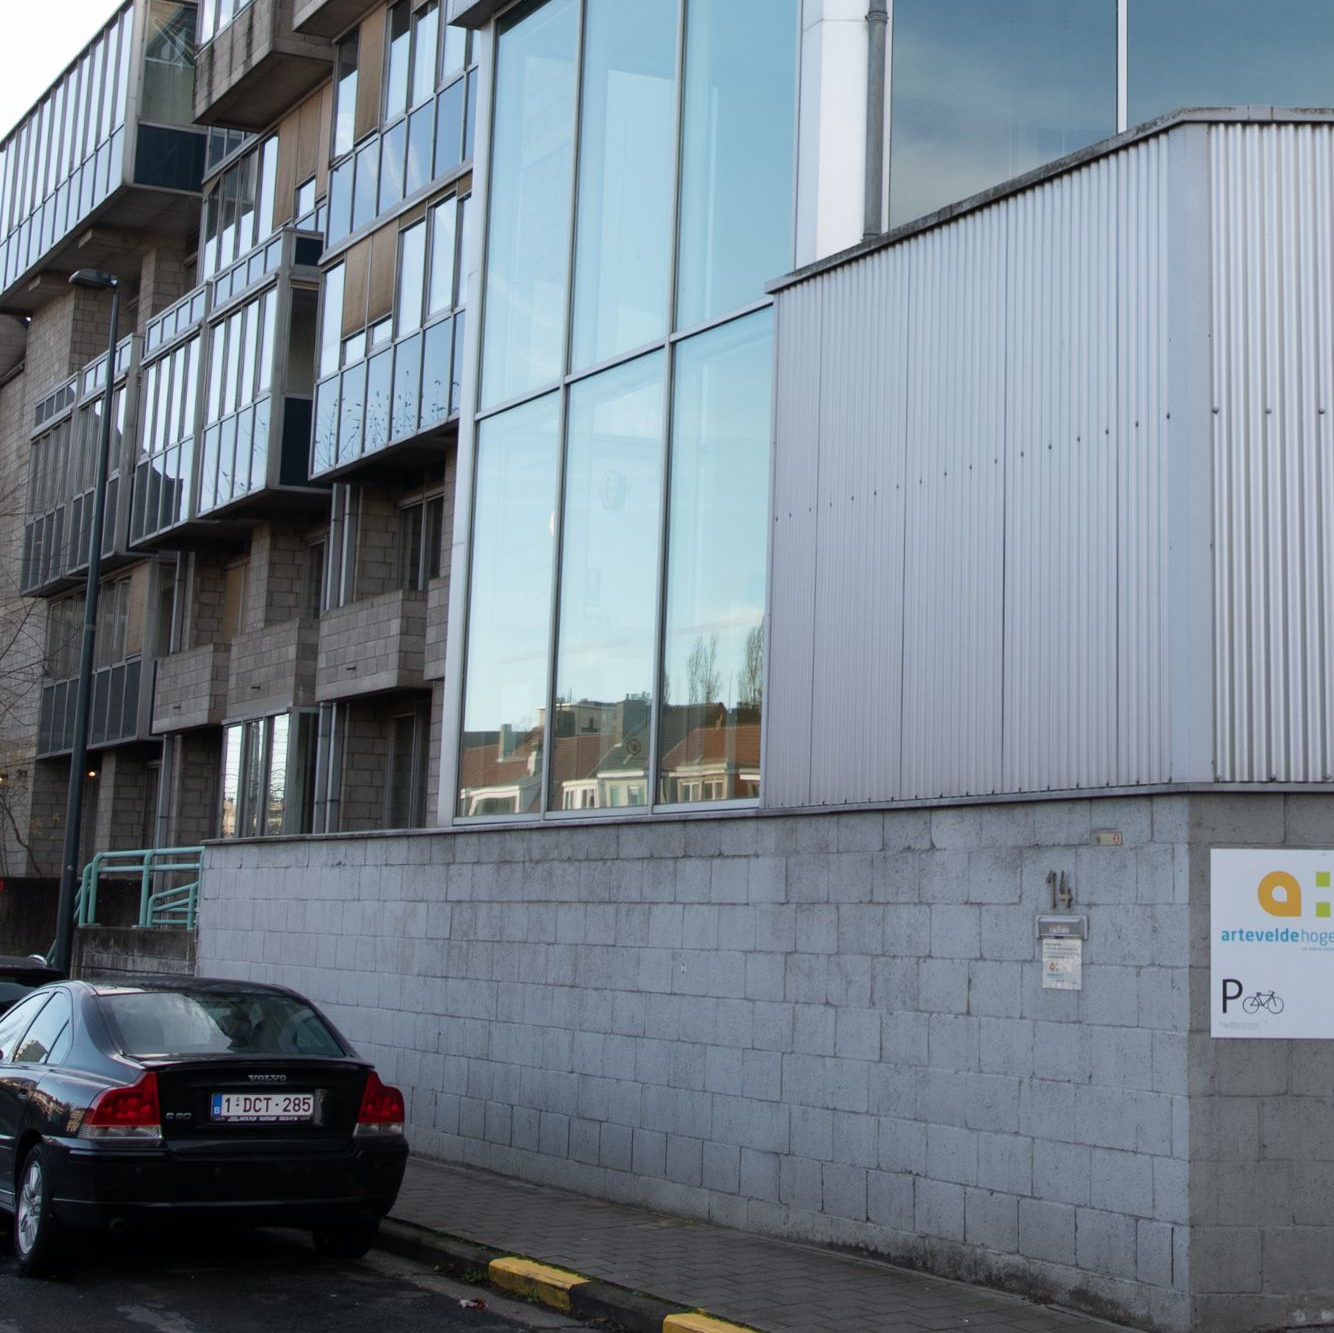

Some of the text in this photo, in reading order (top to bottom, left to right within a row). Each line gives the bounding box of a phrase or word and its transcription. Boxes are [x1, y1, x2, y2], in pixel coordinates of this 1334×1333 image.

[1045, 870, 1073, 909] 14
[1222, 979, 1243, 1013] P
[247, 1074, 287, 1082] VOLVO
